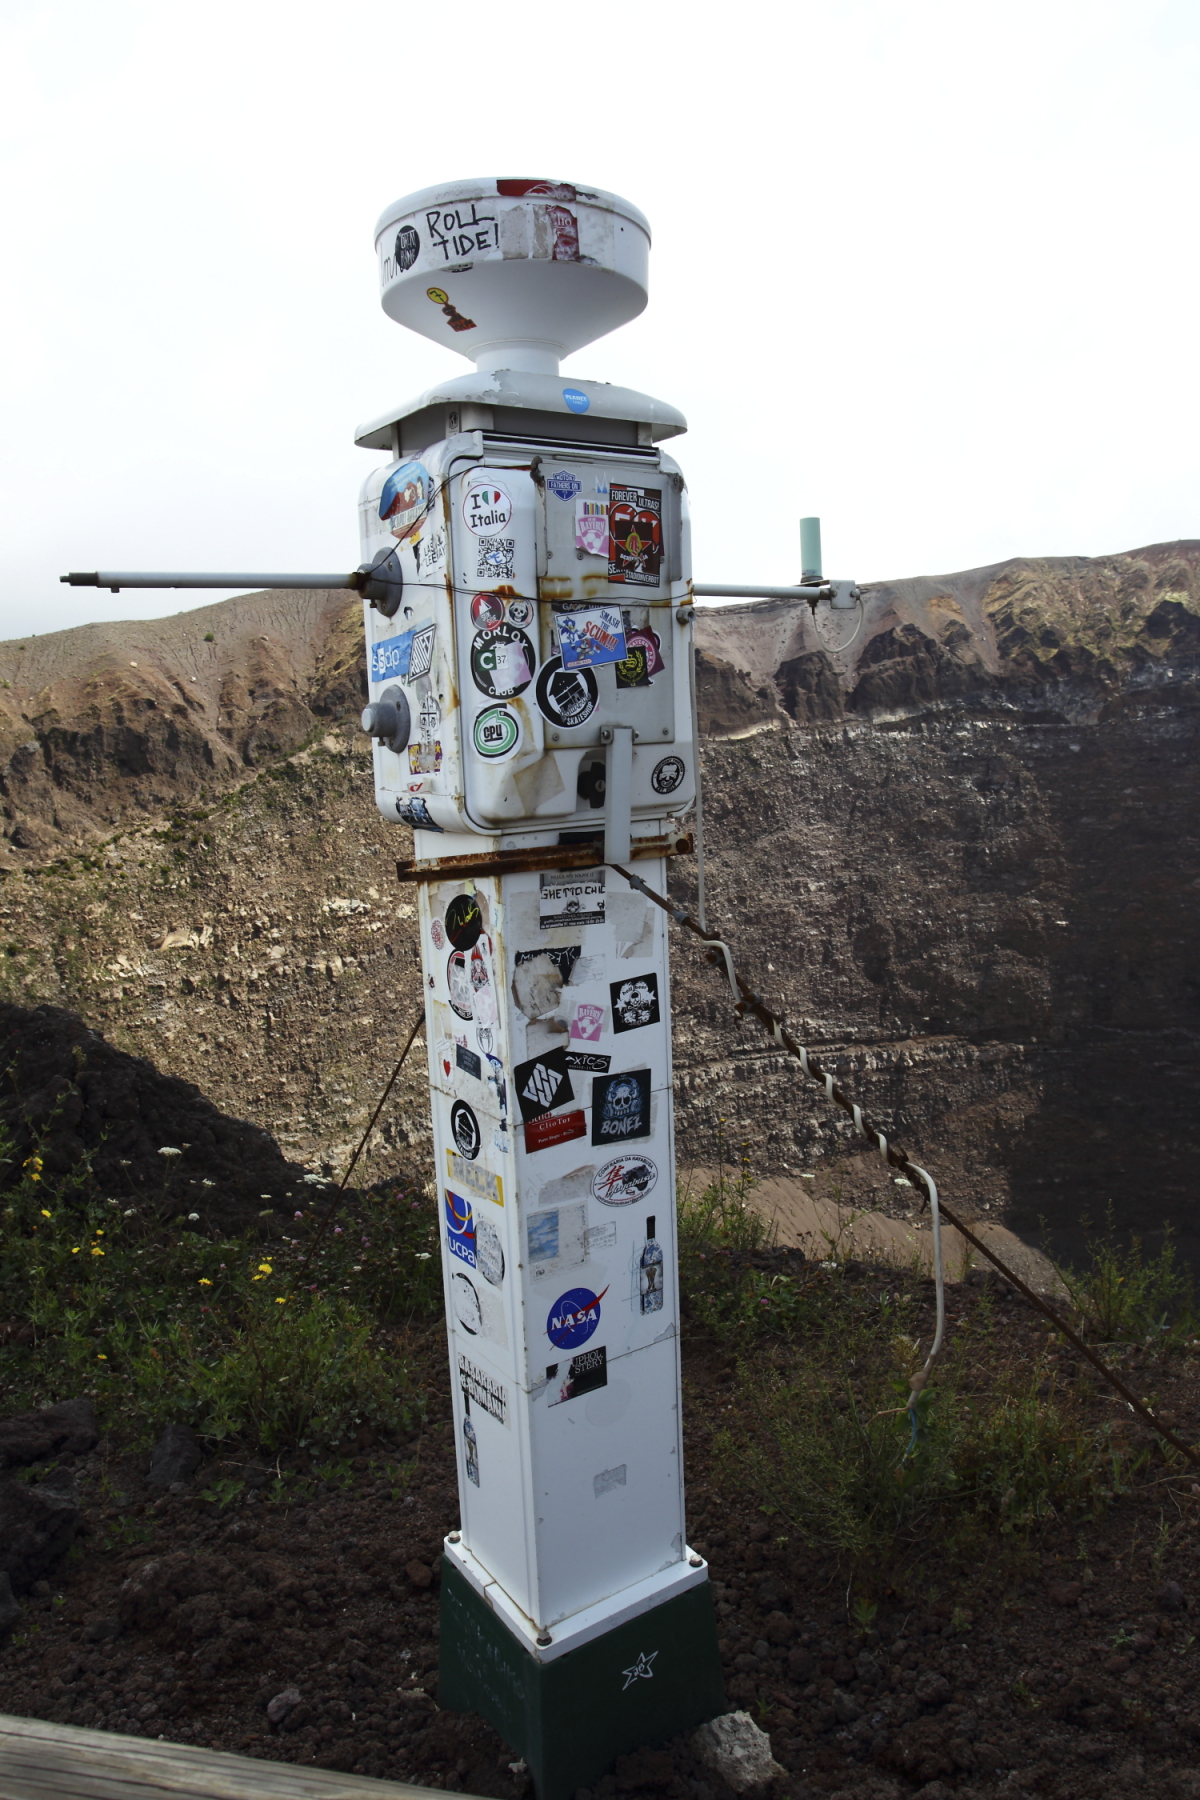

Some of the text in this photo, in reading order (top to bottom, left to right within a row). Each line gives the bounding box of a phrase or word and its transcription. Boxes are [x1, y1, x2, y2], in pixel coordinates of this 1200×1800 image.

[426, 203, 495, 239] ROLL
[433, 223, 500, 260] TIDE!
[471, 494, 481, 510] I
[611, 490, 637, 501] FOREVER
[638, 497, 660, 510] ULTRAS!
[470, 510, 507, 528] Italia
[580, 520, 605, 535] BAYERN
[600, 609, 621, 629] SMASH
[600, 621, 610, 632] THE
[480, 652, 506, 669] C 37
[540, 886, 583, 900] GHETTO
[551, 1308, 598, 1331] NASA
